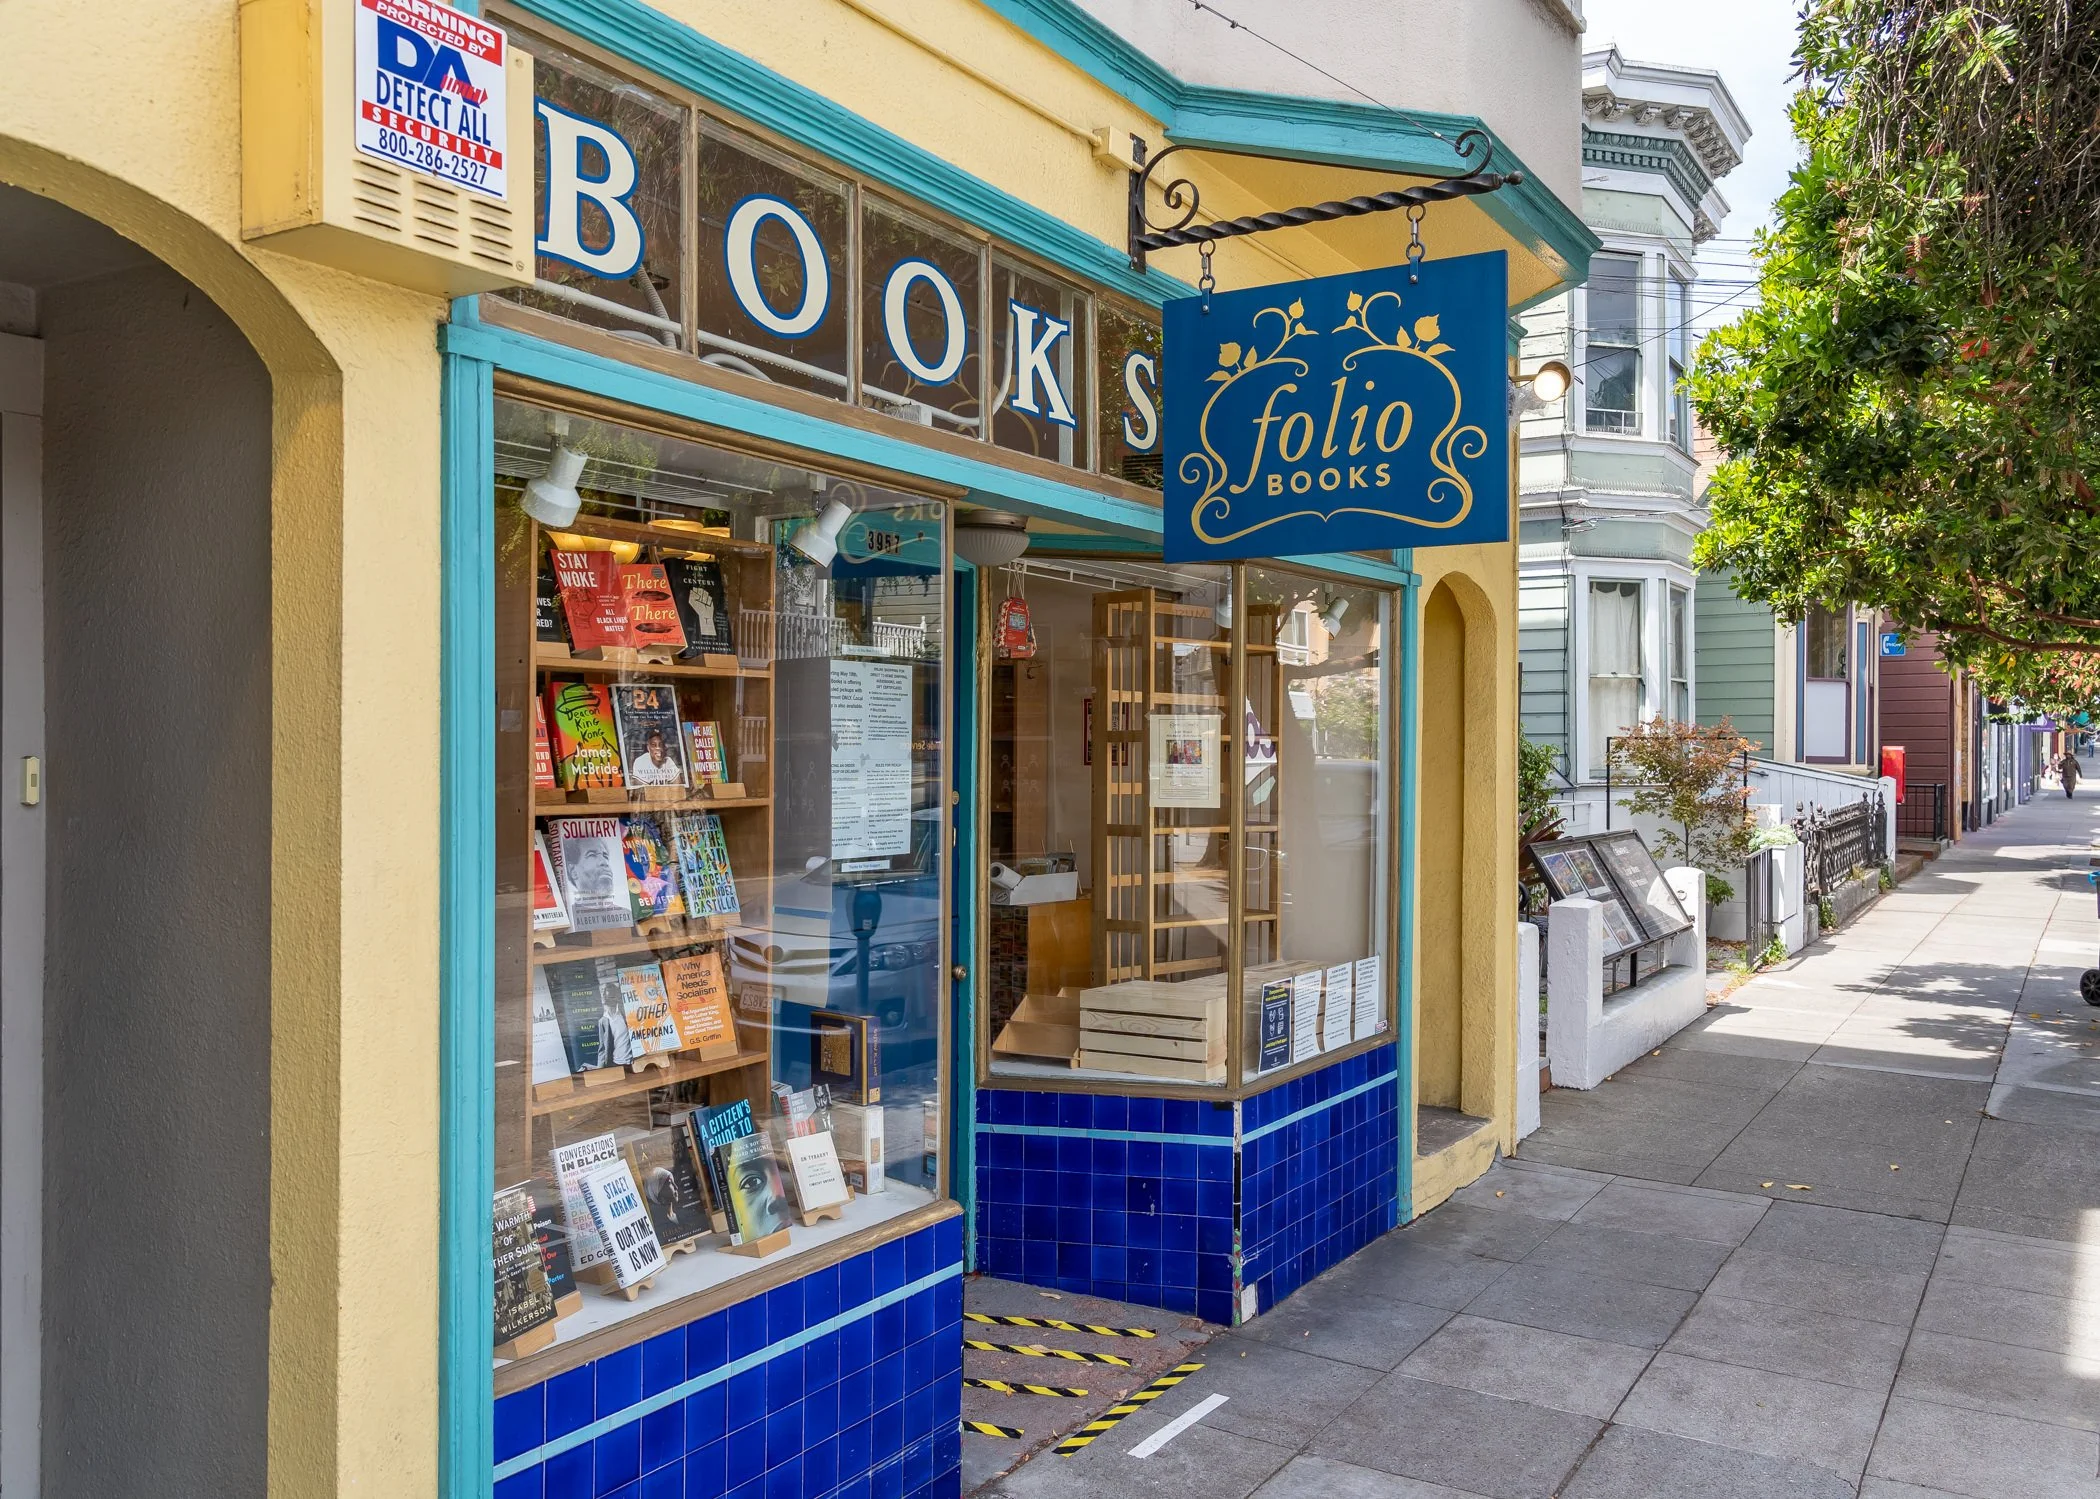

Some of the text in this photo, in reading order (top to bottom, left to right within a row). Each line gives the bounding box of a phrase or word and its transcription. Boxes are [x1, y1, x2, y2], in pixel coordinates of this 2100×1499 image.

[376, 3, 486, 56] PROTECTED BY
[386, 0, 495, 48] ARNING
[377, 15, 480, 109] DA
[376, 70, 492, 147] DETECT ALL
[372, 106, 494, 164] SECURITY
[379, 128, 488, 185] 800-286-2527
[535, 96, 1160, 453] BOOKS
[1229, 376, 1412, 494] folio
[1268, 463, 1390, 496] BOOKS
[868, 531, 900, 554] 3957
[558, 552, 588, 569] STAY
[560, 572, 598, 588] WOKE
[622, 573, 667, 590] There
[632, 604, 676, 621] There
[633, 689, 659, 710] 24
[566, 708, 600, 720] Deacon
[575, 718, 600, 731] King
[692, 726, 713, 736] WE ARE
[580, 728, 604, 744] Kong
[694, 739, 715, 748] CALLED
[575, 744, 612, 758] James
[696, 750, 718, 760] TO BE A
[571, 762, 618, 775] McBride
[694, 761, 723, 772] MOVEMENT
[562, 820, 617, 839] SOLITARY
[550, 824, 563, 868] SOLITARY
[694, 897, 736, 914] CASTILLO
[576, 913, 630, 926] ALBERT WOODFOX
[682, 961, 701, 971] Why
[676, 969, 711, 982] America
[676, 986, 717, 1000] Socialism
[682, 980, 709, 990] Needs
[622, 990, 639, 1004] THE
[637, 1003, 668, 1021] OTHER
[631, 1025, 674, 1042] AMERICANS
[702, 1033, 722, 1042] Griffin
[701, 1124, 709, 1140] A
[708, 1098, 751, 1136] CITIZEN'S
[740, 1119, 753, 1137] TO
[559, 1137, 614, 1162] CONVERSATIONS
[750, 1145, 770, 1155] WRIGHT
[562, 1161, 575, 1172] IN
[577, 1149, 616, 1168] BLACK
[604, 1176, 630, 1199] STACEY
[610, 1193, 638, 1219] ABRAMS
[495, 1211, 530, 1232] WARMTH
[534, 1219, 552, 1230] Poison
[504, 1234, 514, 1246] OF
[582, 1182, 624, 1280] STACEY ABRAMS OUR TIME IS NOW
[616, 1216, 653, 1251] OUR TIME
[493, 1241, 538, 1269] THER SUNS
[580, 1253, 595, 1264] ED
[629, 1241, 659, 1272] IS NOW
[509, 1296, 540, 1316] ISABEL
[501, 1304, 552, 1334] WILKERSON
